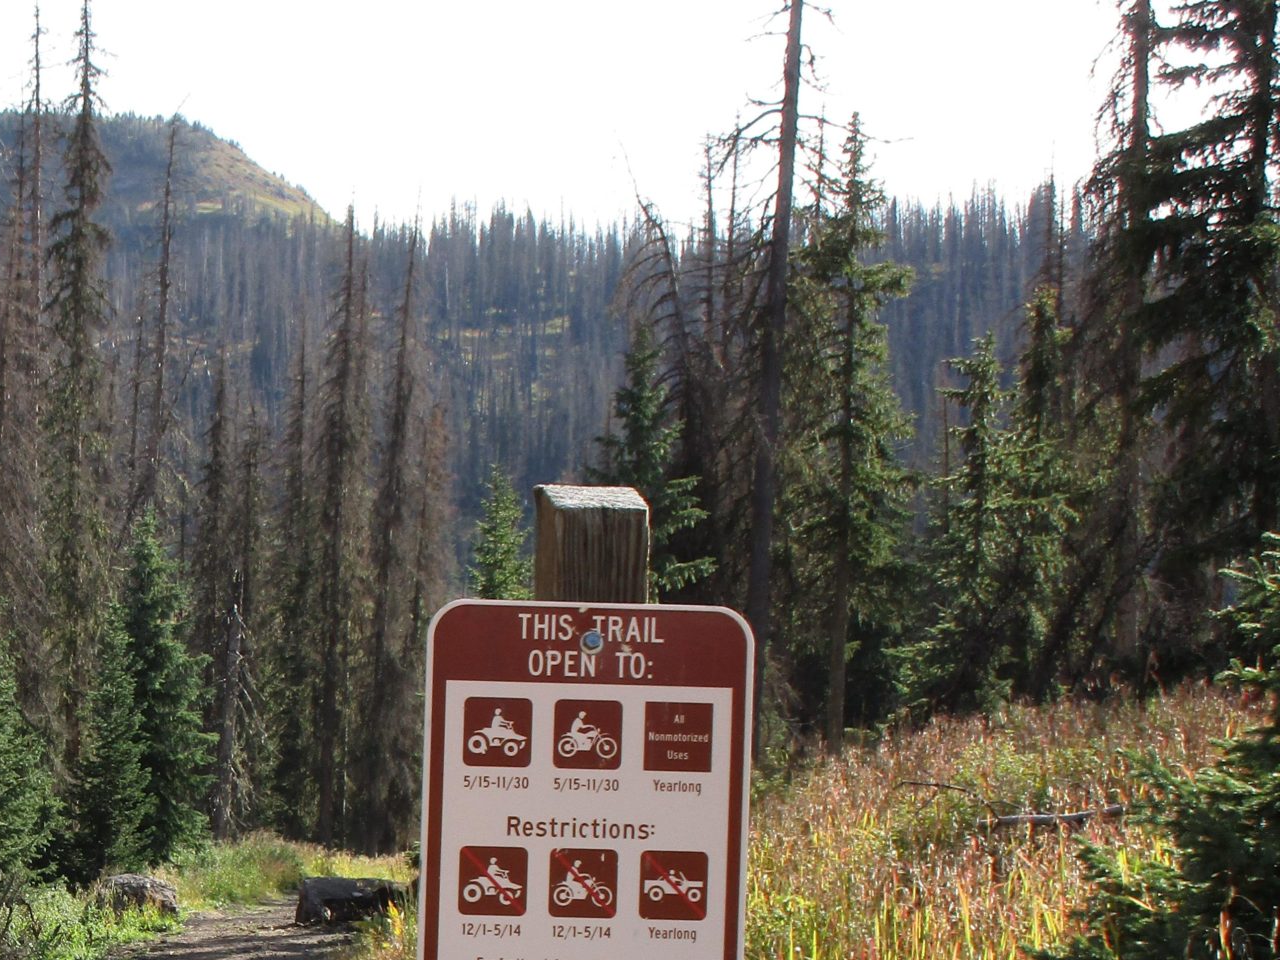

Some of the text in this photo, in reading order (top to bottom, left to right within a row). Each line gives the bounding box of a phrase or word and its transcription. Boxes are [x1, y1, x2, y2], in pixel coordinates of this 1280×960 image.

[518, 613, 664, 643] THIS TRAIL
[528, 649, 653, 679] OPEN TO:
[674, 715, 684, 724] All
[648, 732, 709, 743] Nonmotorized
[667, 750, 688, 760] Uses
[463, 776, 529, 790] 5/15-11/30
[553, 778, 619, 792] 5/15-11/30
[653, 780, 701, 796] Yearlong
[506, 816, 656, 840] Restrictions:
[461, 923, 521, 938] 12/1-5/14
[552, 925, 611, 940] 12/1-5/14
[648, 927, 697, 943] Yearlong
